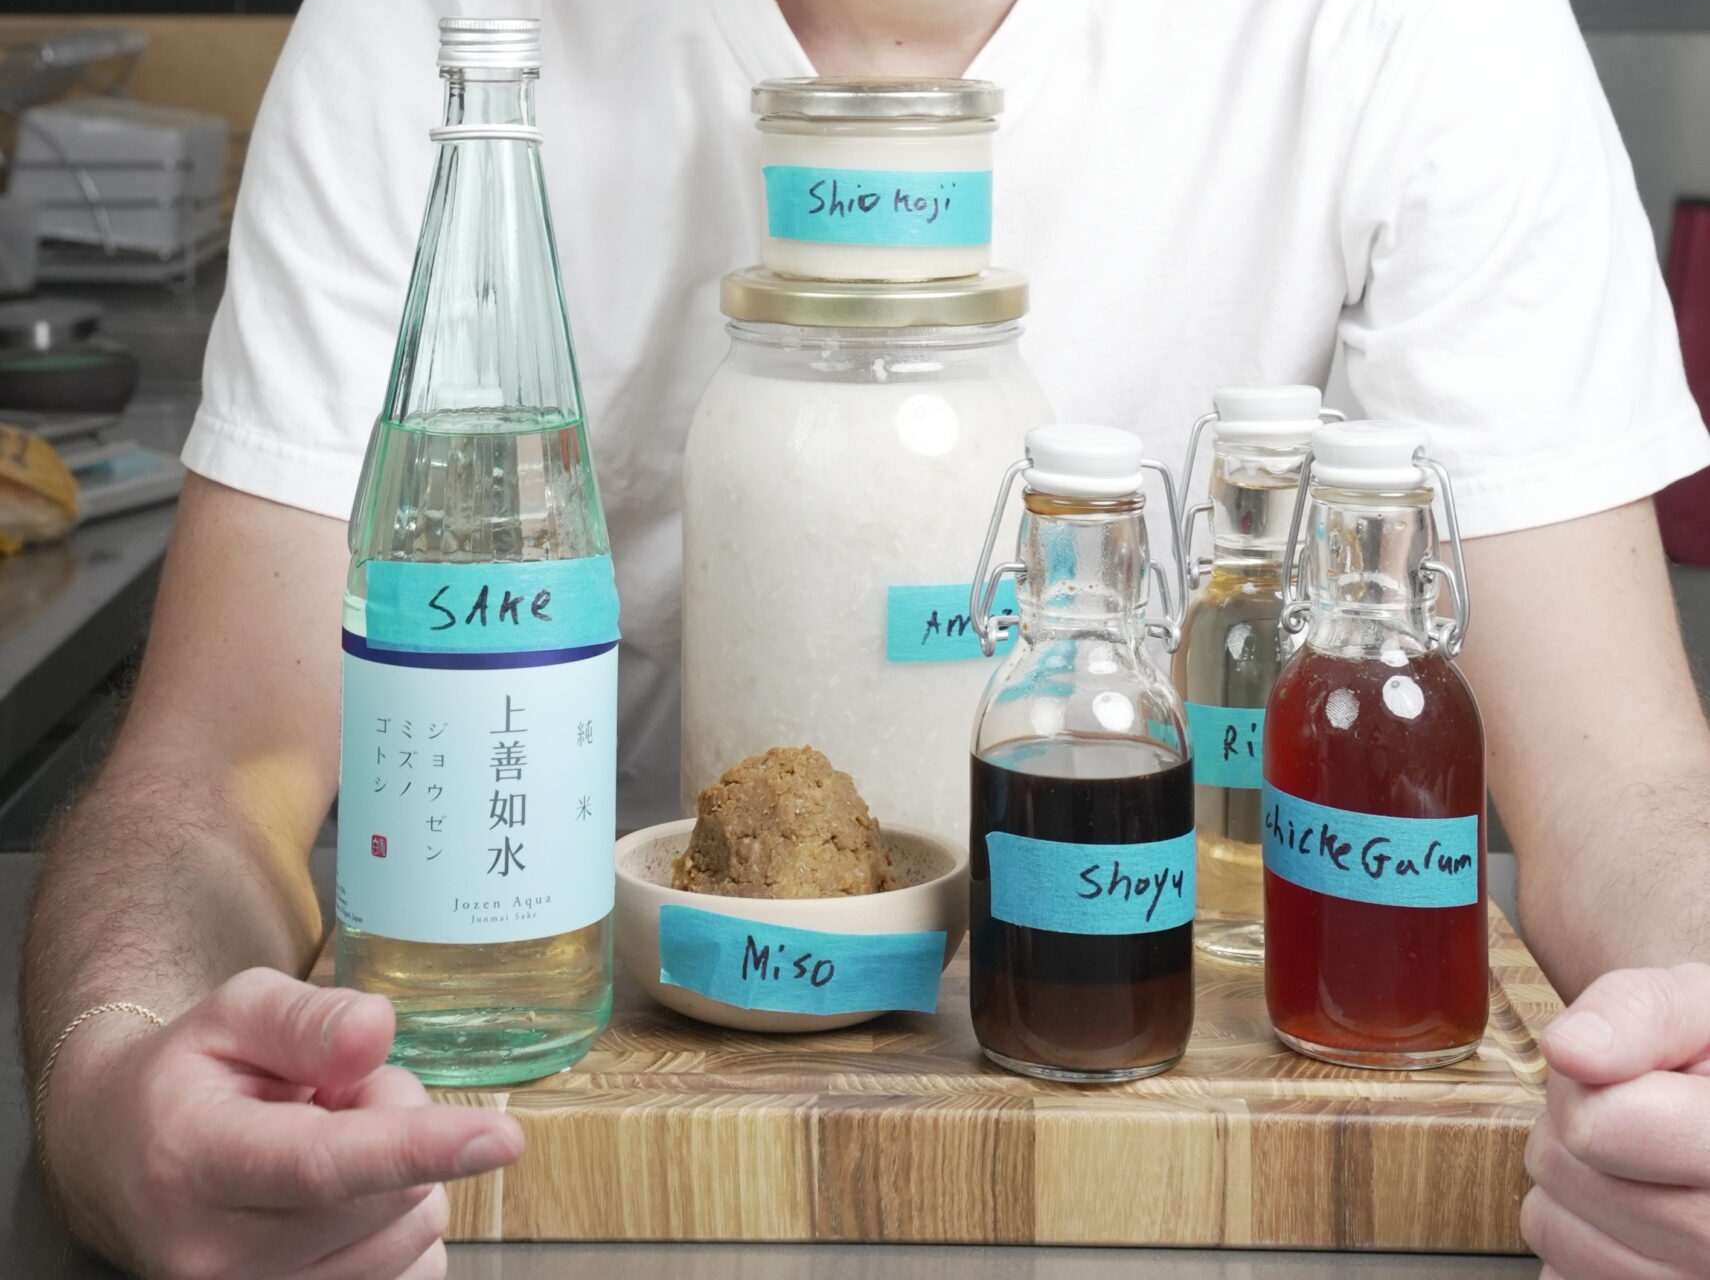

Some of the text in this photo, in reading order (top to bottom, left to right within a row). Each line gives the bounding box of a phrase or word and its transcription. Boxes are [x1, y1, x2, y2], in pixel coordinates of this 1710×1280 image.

[808, 179, 881, 218] Shio
[373, 717, 392, 794] ゴトシ
[398, 719, 418, 797] ミズノ
[486, 694, 529, 877] 上善如水
[575, 719, 594, 822] 純米
[452, 895, 552, 913] Jozen Aqua
[470, 911, 537, 925] Junmai Sake
[1075, 859, 1185, 923] Shoyu
[741, 934, 836, 988] Miso
